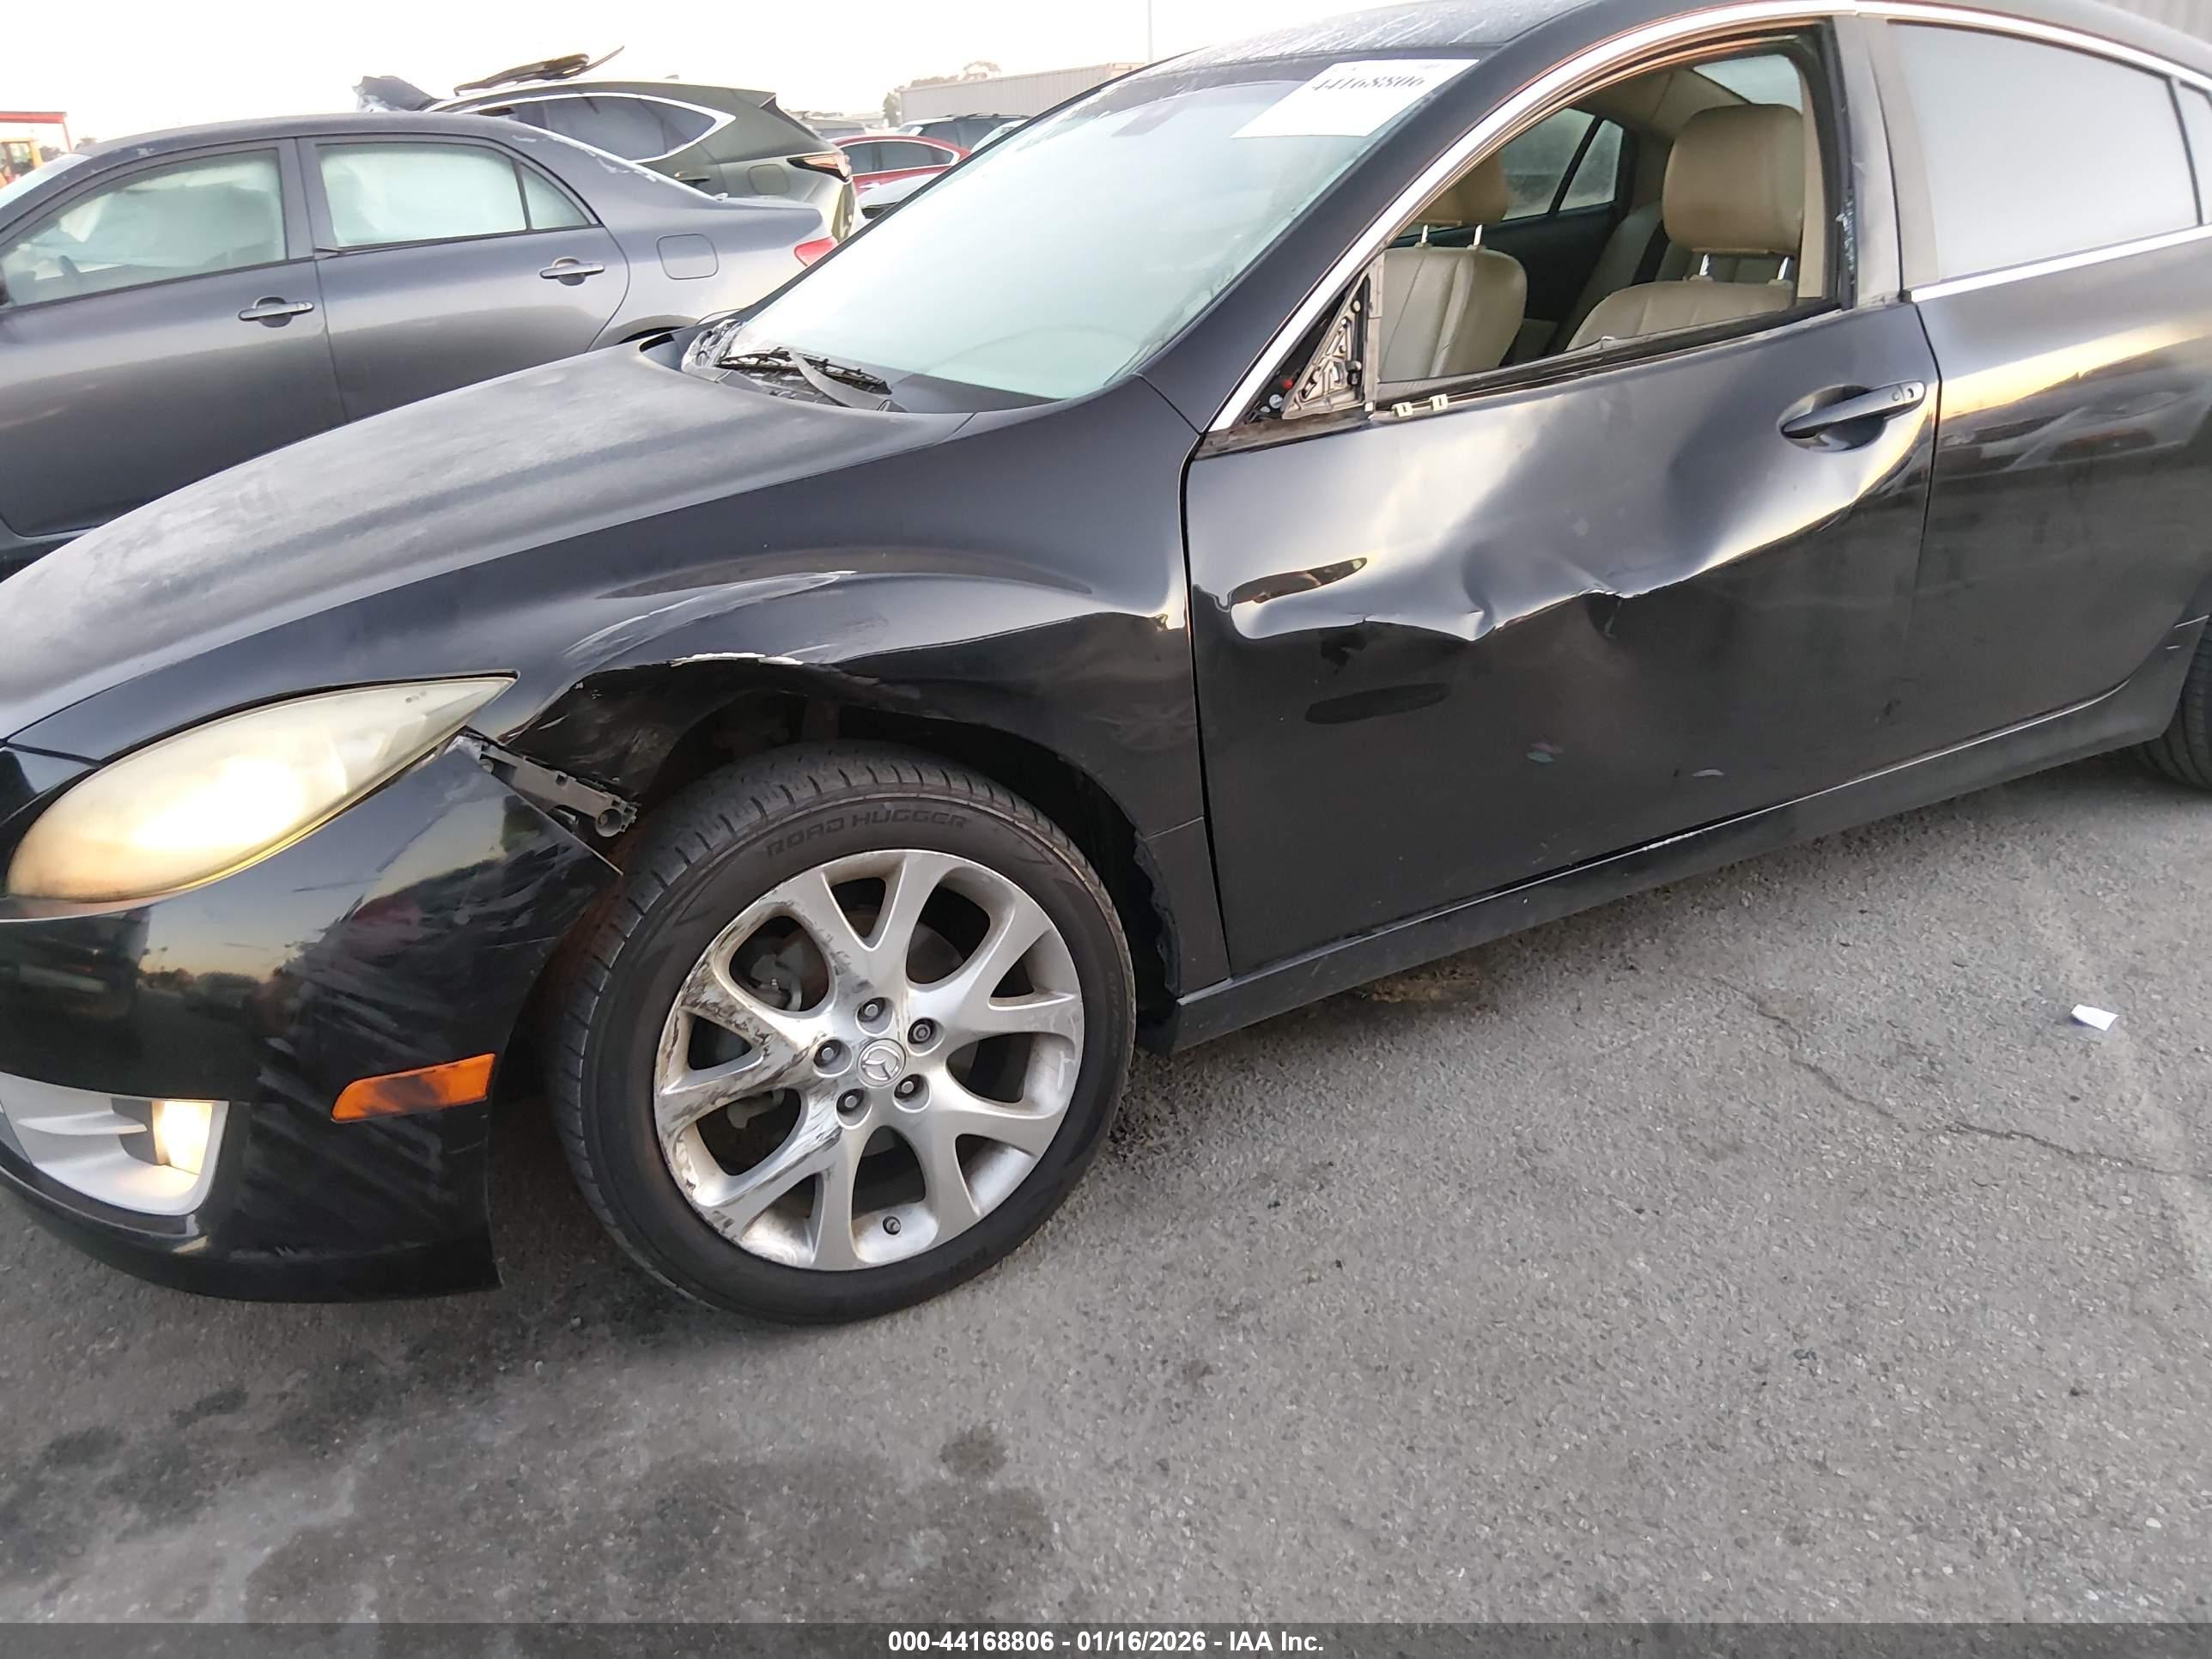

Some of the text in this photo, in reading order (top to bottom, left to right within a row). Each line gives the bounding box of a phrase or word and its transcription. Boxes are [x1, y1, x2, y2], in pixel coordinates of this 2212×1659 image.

[1311, 75, 1426, 92] 44168806
[764, 808, 969, 858] ROAD HUGGER
